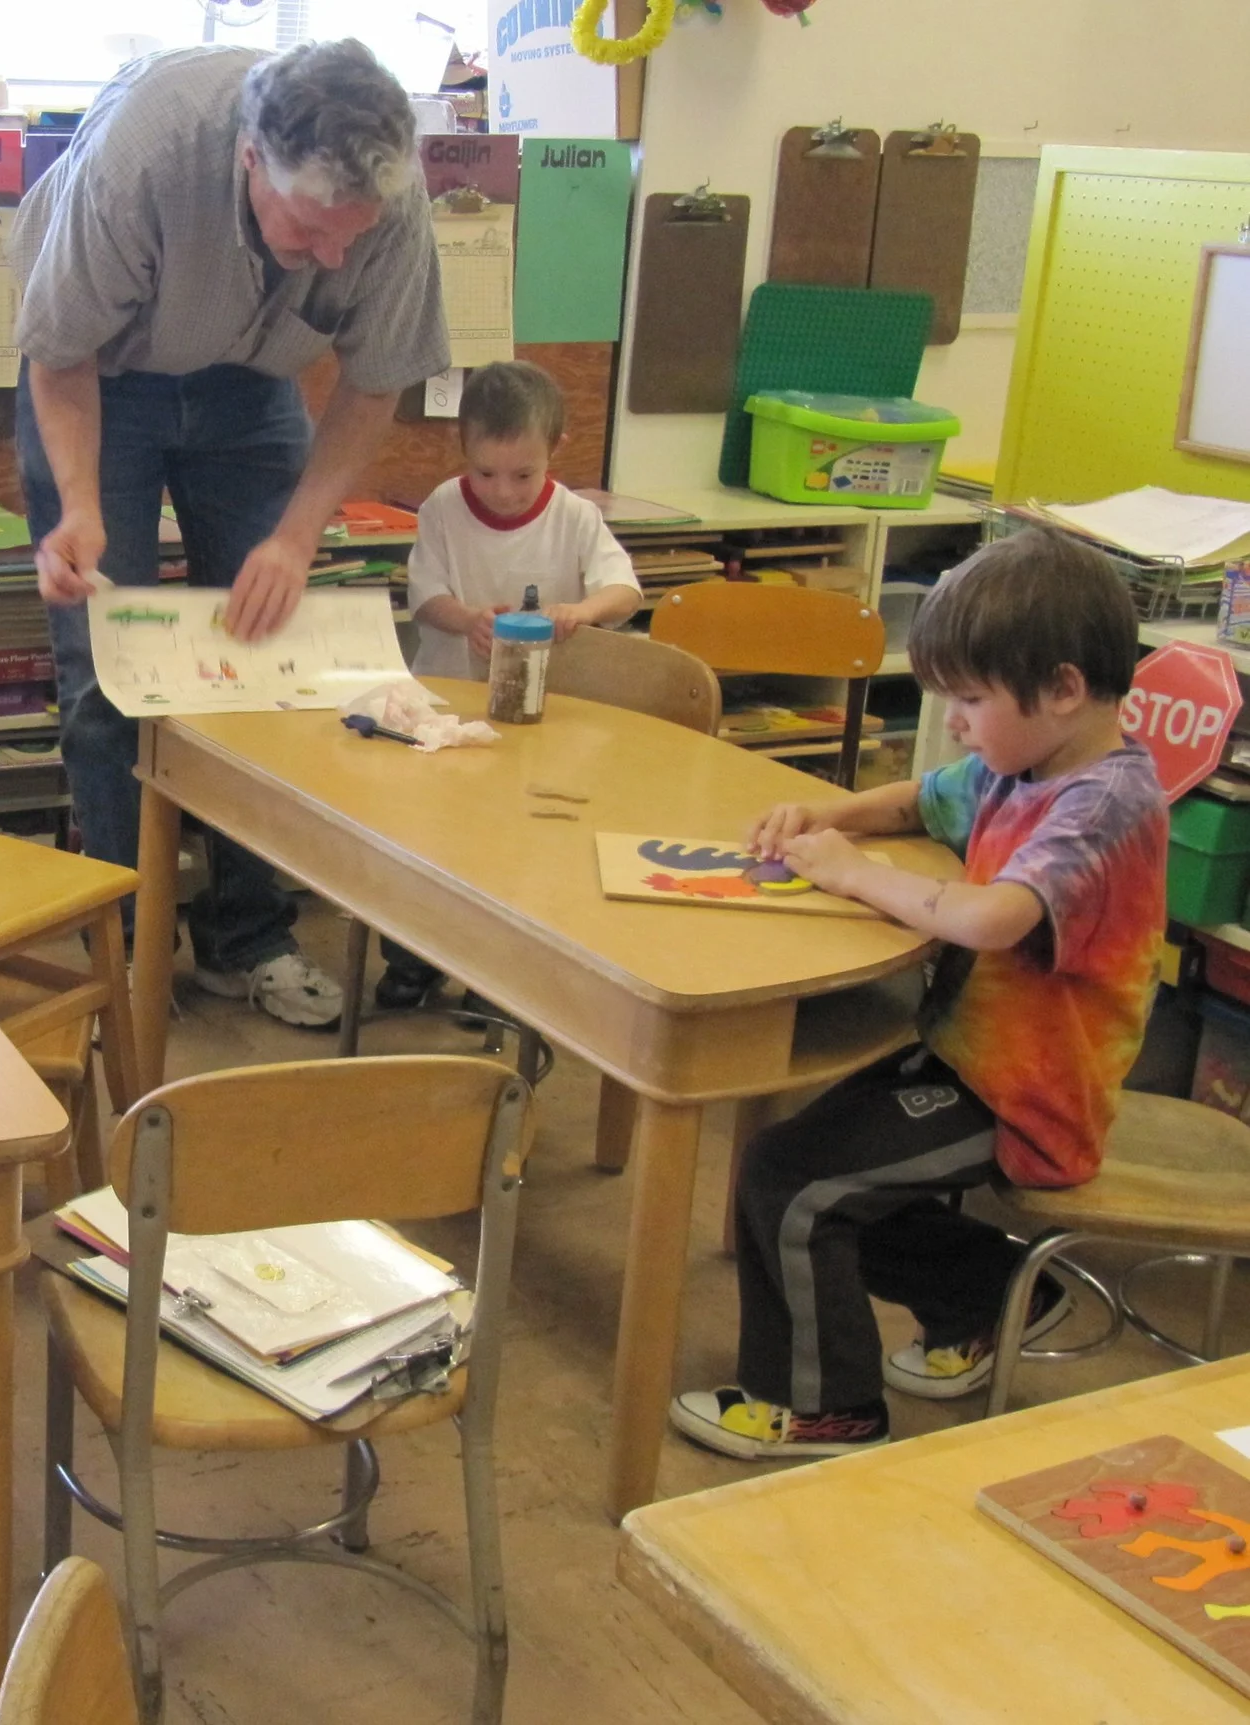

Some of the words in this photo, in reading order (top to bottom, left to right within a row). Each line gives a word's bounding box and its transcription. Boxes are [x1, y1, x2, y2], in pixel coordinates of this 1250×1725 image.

[510, 47, 542, 63] MOVING
[540, 144, 606, 169] Julian
[1120, 687, 1223, 749] STOP
